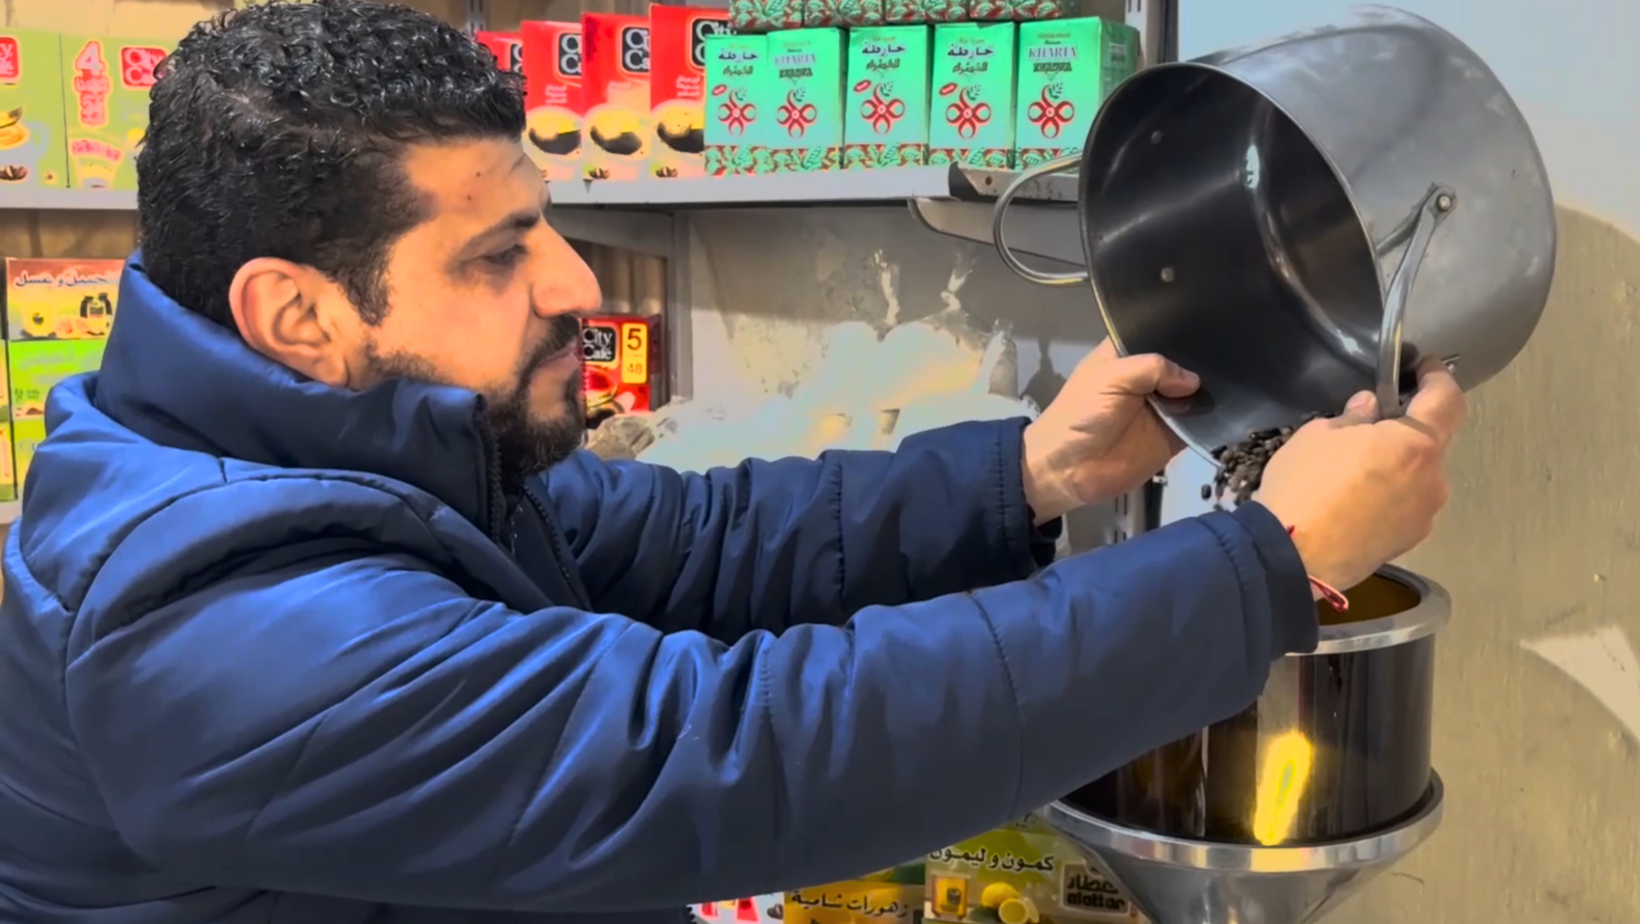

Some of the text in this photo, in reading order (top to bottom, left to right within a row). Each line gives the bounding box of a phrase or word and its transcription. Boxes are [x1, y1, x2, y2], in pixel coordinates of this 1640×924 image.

[583, 328, 613, 347] City
[626, 328, 643, 351] 5
[627, 363, 643, 375] 48
[990, 853, 999, 868] و
[1002, 852, 1055, 873] كمون
[846, 895, 910, 918] زهورات
